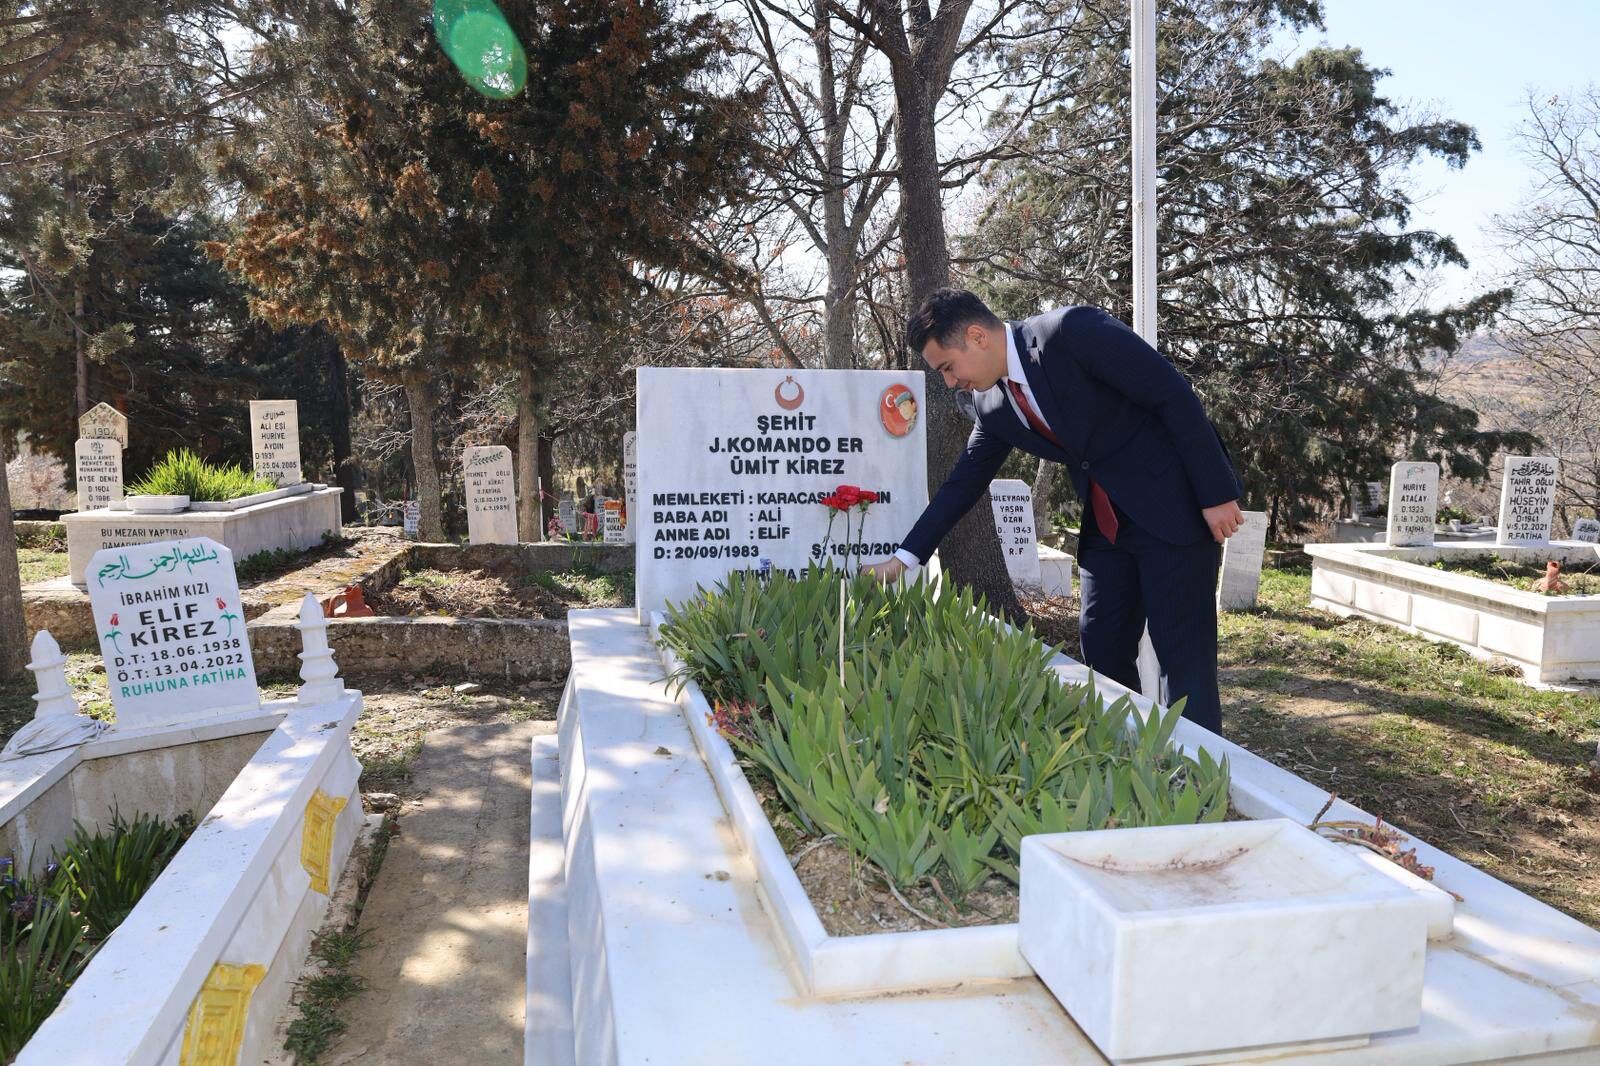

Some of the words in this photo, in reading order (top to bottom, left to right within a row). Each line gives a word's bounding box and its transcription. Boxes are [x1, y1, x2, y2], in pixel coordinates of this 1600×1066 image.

[275, 422, 286, 431] EŞİ
[757, 412, 816, 434] ŞEHİT
[709, 437, 830, 453] J.KOMANDO
[837, 438, 863, 452] ER
[730, 456, 780, 475] ÜMİT
[786, 456, 845, 474] KİREZ
[1510, 478, 1531, 486] TAHİR
[1536, 477, 1554, 486] OĞLU
[653, 490, 744, 505] MEMLEKETİ
[1514, 486, 1547, 494] HASAN
[1510, 495, 1549, 506] HÜSEYİN
[654, 511, 697, 523] BABA
[701, 511, 728, 522] ADI
[758, 507, 781, 521] ALİ
[1511, 506, 1546, 515] ATALAY
[101, 528, 112, 537] BU
[115, 528, 146, 537] MEZARI
[654, 528, 699, 541] ANNE
[704, 528, 730, 540] ADI
[758, 524, 790, 539] ELİF
[654, 546, 671, 559] D:
[675, 545, 759, 559] 20/09/1983
[120, 586, 180, 606] İBRAHİM
[184, 582, 210, 597] KIZI
[139, 602, 198, 625] ELİF
[130, 621, 216, 647] KİREZ
[115, 654, 146, 667] D.T:
[152, 639, 241, 662] 18.06.1938
[118, 668, 149, 682] Ö.T:
[155, 654, 244, 676] 13.04.2022
[121, 677, 189, 698] RUHUNA
[192, 667, 246, 686] FATİHA
